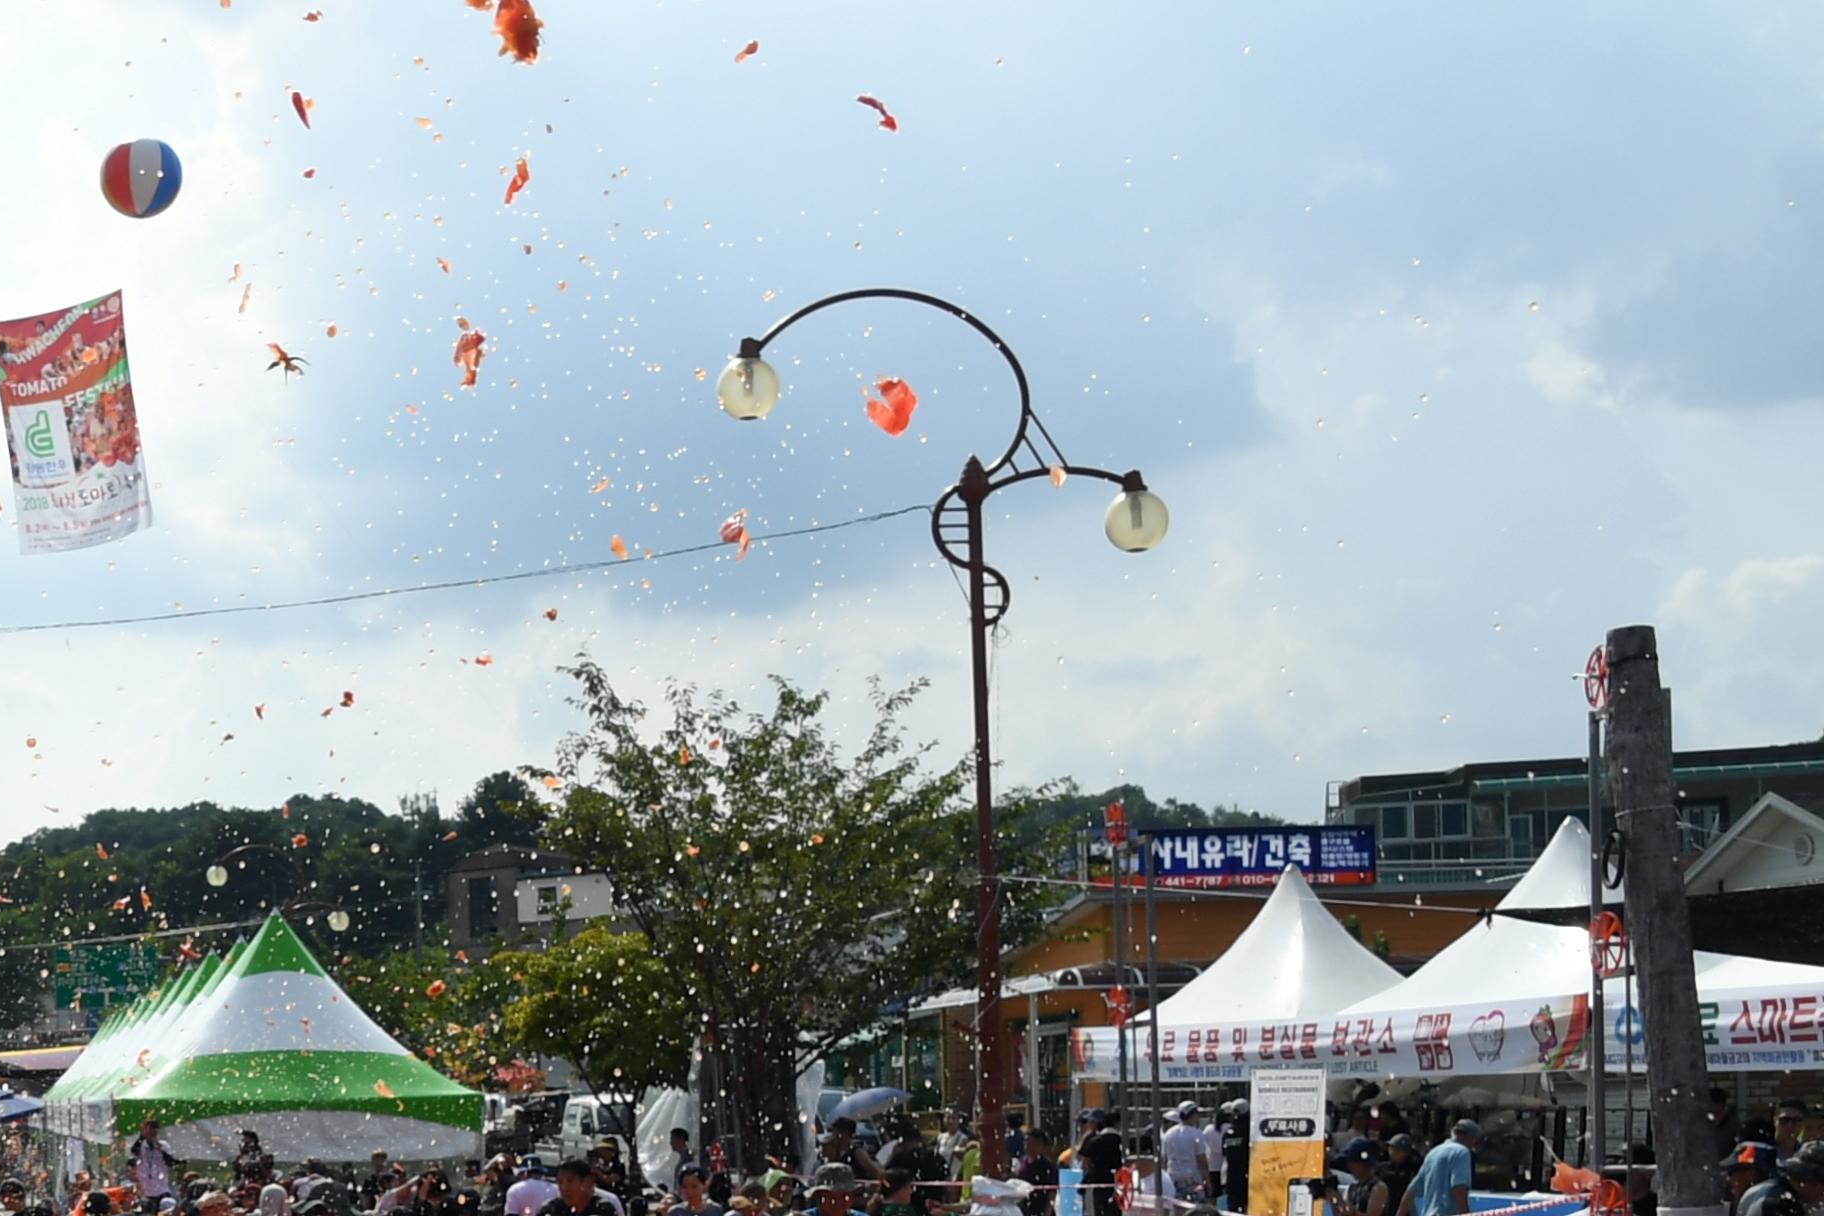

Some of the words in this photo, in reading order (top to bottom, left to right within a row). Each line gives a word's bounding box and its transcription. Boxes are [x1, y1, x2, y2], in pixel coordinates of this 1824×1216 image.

[9, 376, 68, 398] TOMATO
[23, 496, 50, 511] 2018
[77, 481, 118, 507] 토마토
[1729, 996, 1824, 1046] 스마트
[1186, 1029, 1220, 1063] 물품
[1232, 1026, 1248, 1062] 및
[1258, 1023, 1319, 1061] 분실물
[1331, 1016, 1398, 1057] 보관소
[1267, 1119, 1308, 1133] 무료사용
